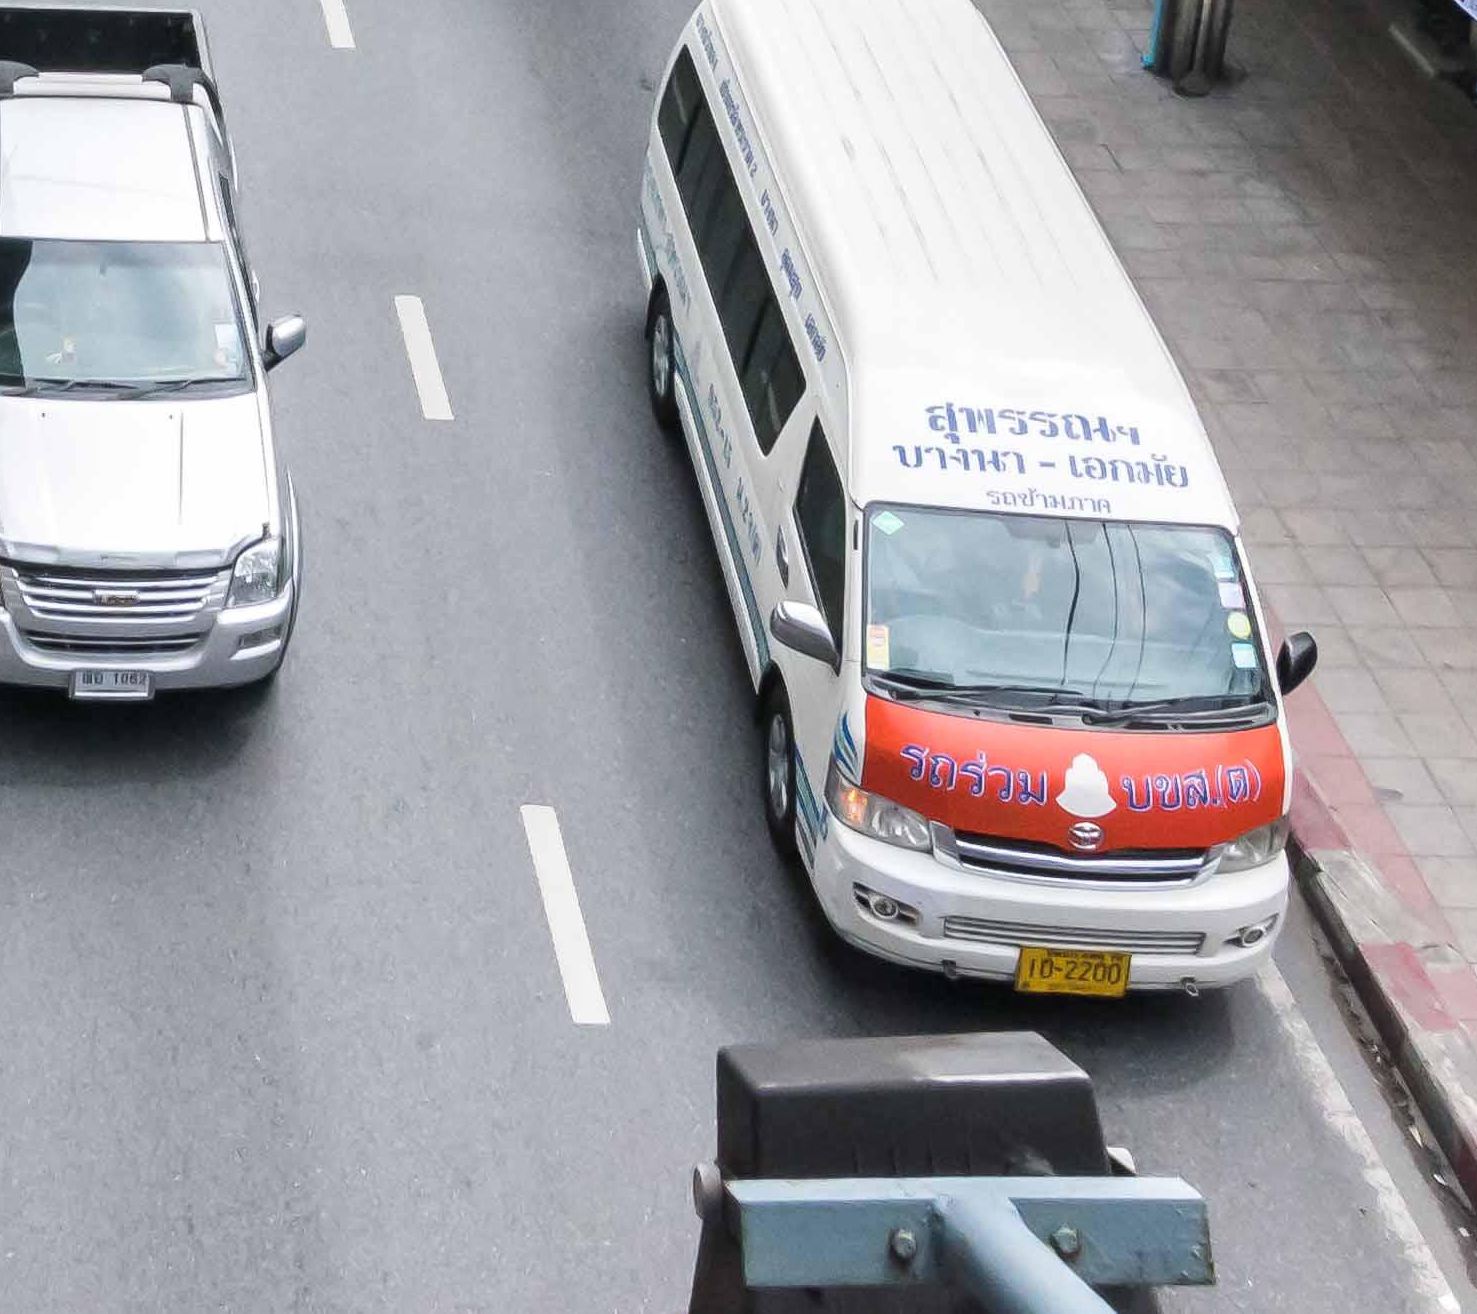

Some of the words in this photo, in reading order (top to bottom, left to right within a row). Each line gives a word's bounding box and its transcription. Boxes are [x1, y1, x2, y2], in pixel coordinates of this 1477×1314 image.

[924, 402, 1141, 445] สุพรรณฯ
[892, 444, 1026, 475] บางนา
[1069, 454, 1190, 488] เอกมัย
[987, 488, 1112, 513] รถข้ามภาค
[900, 743, 1049, 806] รถร่วม
